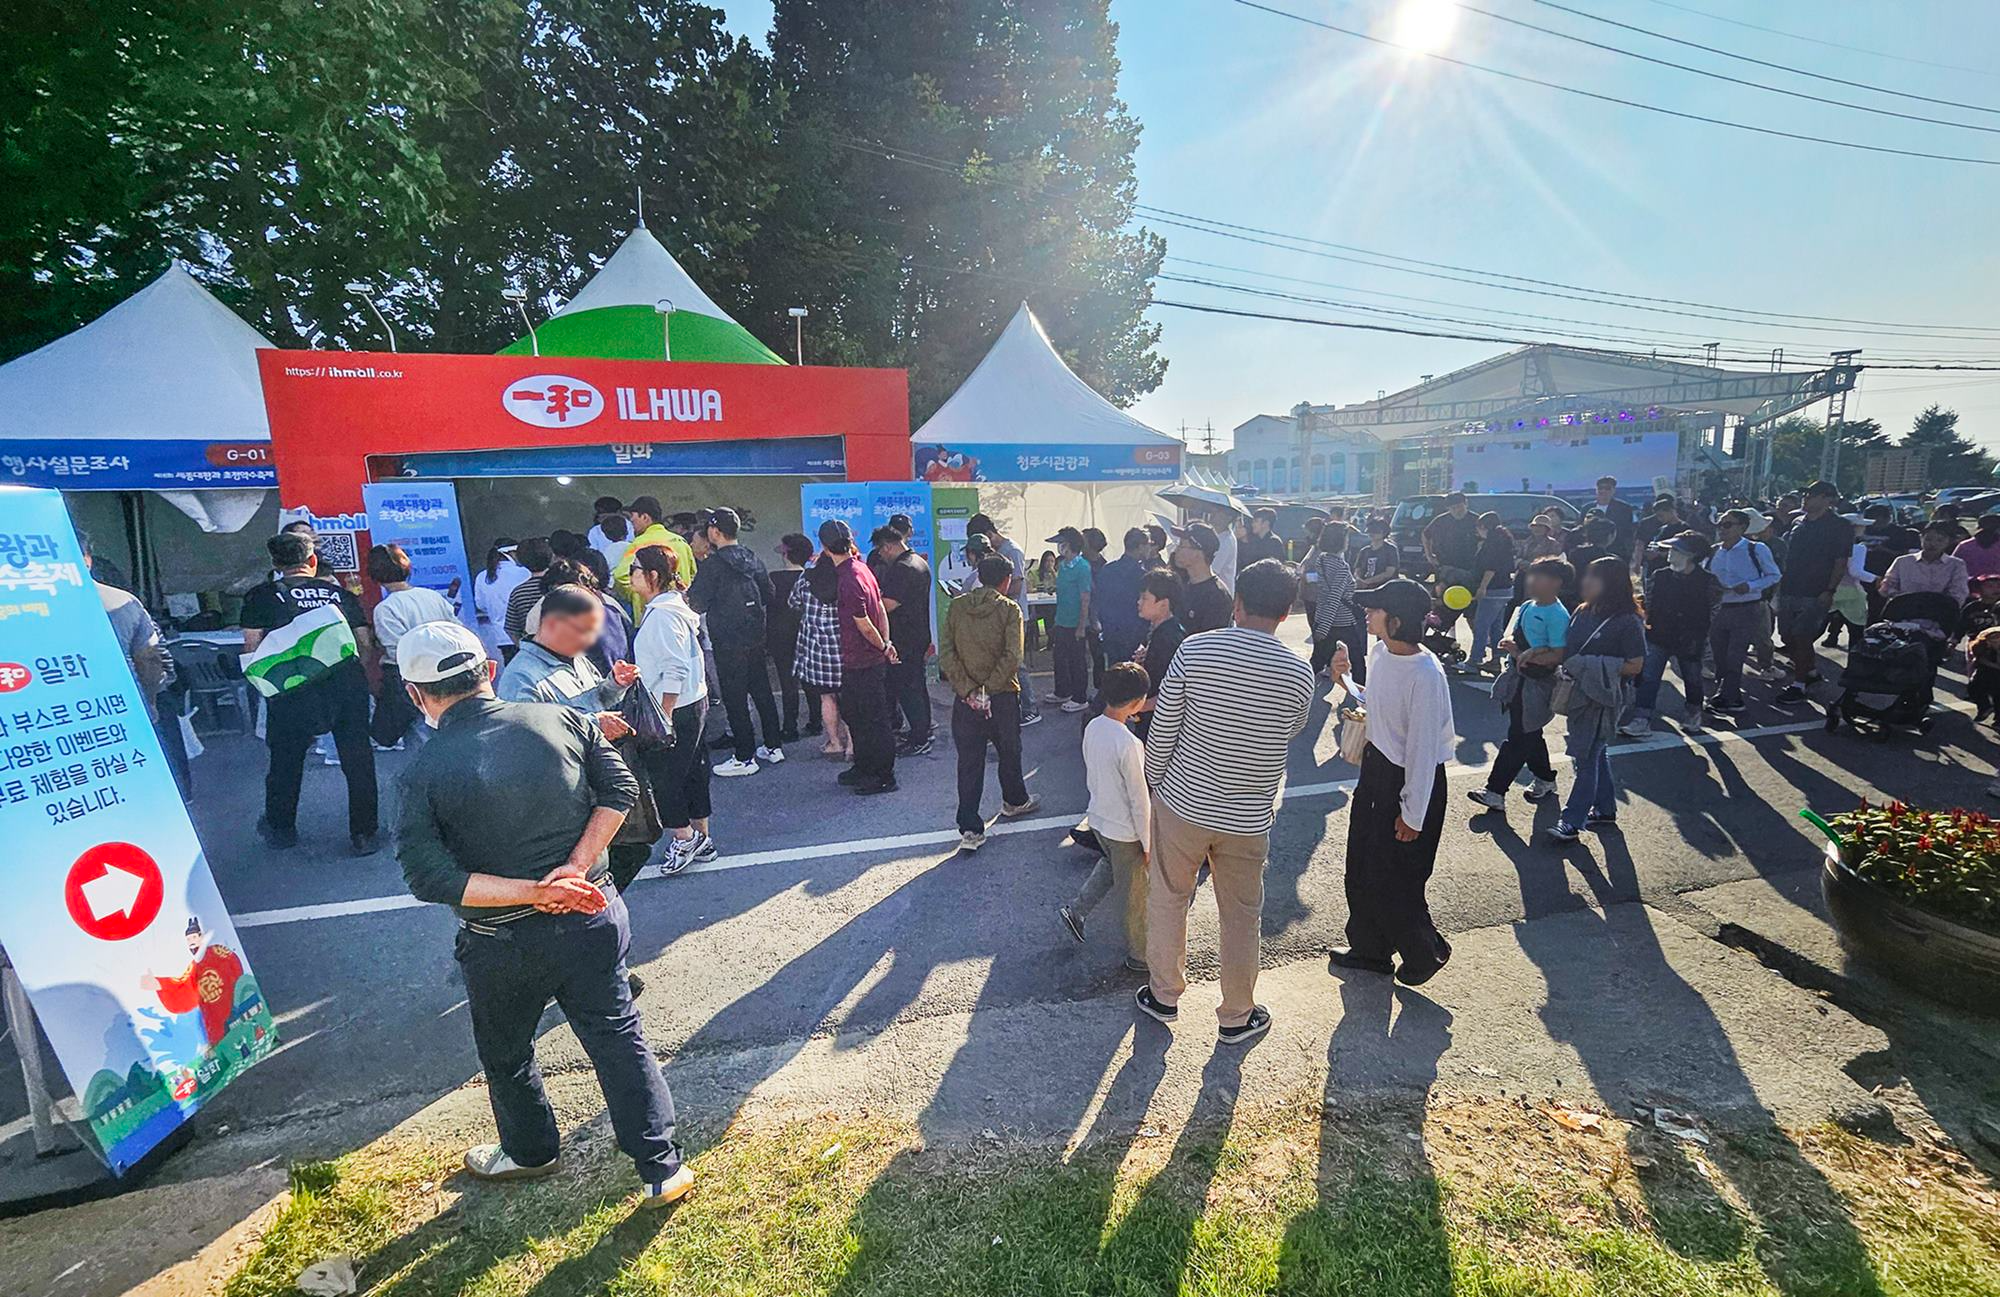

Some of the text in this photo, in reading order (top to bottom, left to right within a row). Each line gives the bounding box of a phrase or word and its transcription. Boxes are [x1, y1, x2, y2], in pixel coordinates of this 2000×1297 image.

[328, 367, 402, 378] ihmall.co.kr
[616, 387, 723, 422] ILHWA
[1, 455, 130, 476] 행사설문조사
[226, 449, 267, 461] G-01
[1016, 455, 1090, 471] 청주시관광과
[1145, 452, 1170, 461] G-03
[381, 498, 443, 512] 세종대왕과
[309, 513, 367, 530] hmall
[35, 653, 90, 685] 일화
[12, 704, 74, 734] 부스로
[75, 693, 129, 721] 오시면
[55, 722, 129, 757] 이벤트와
[0, 748, 147, 810] 료 체험을 하실 수
[45, 785, 127, 826] 있습니다.
